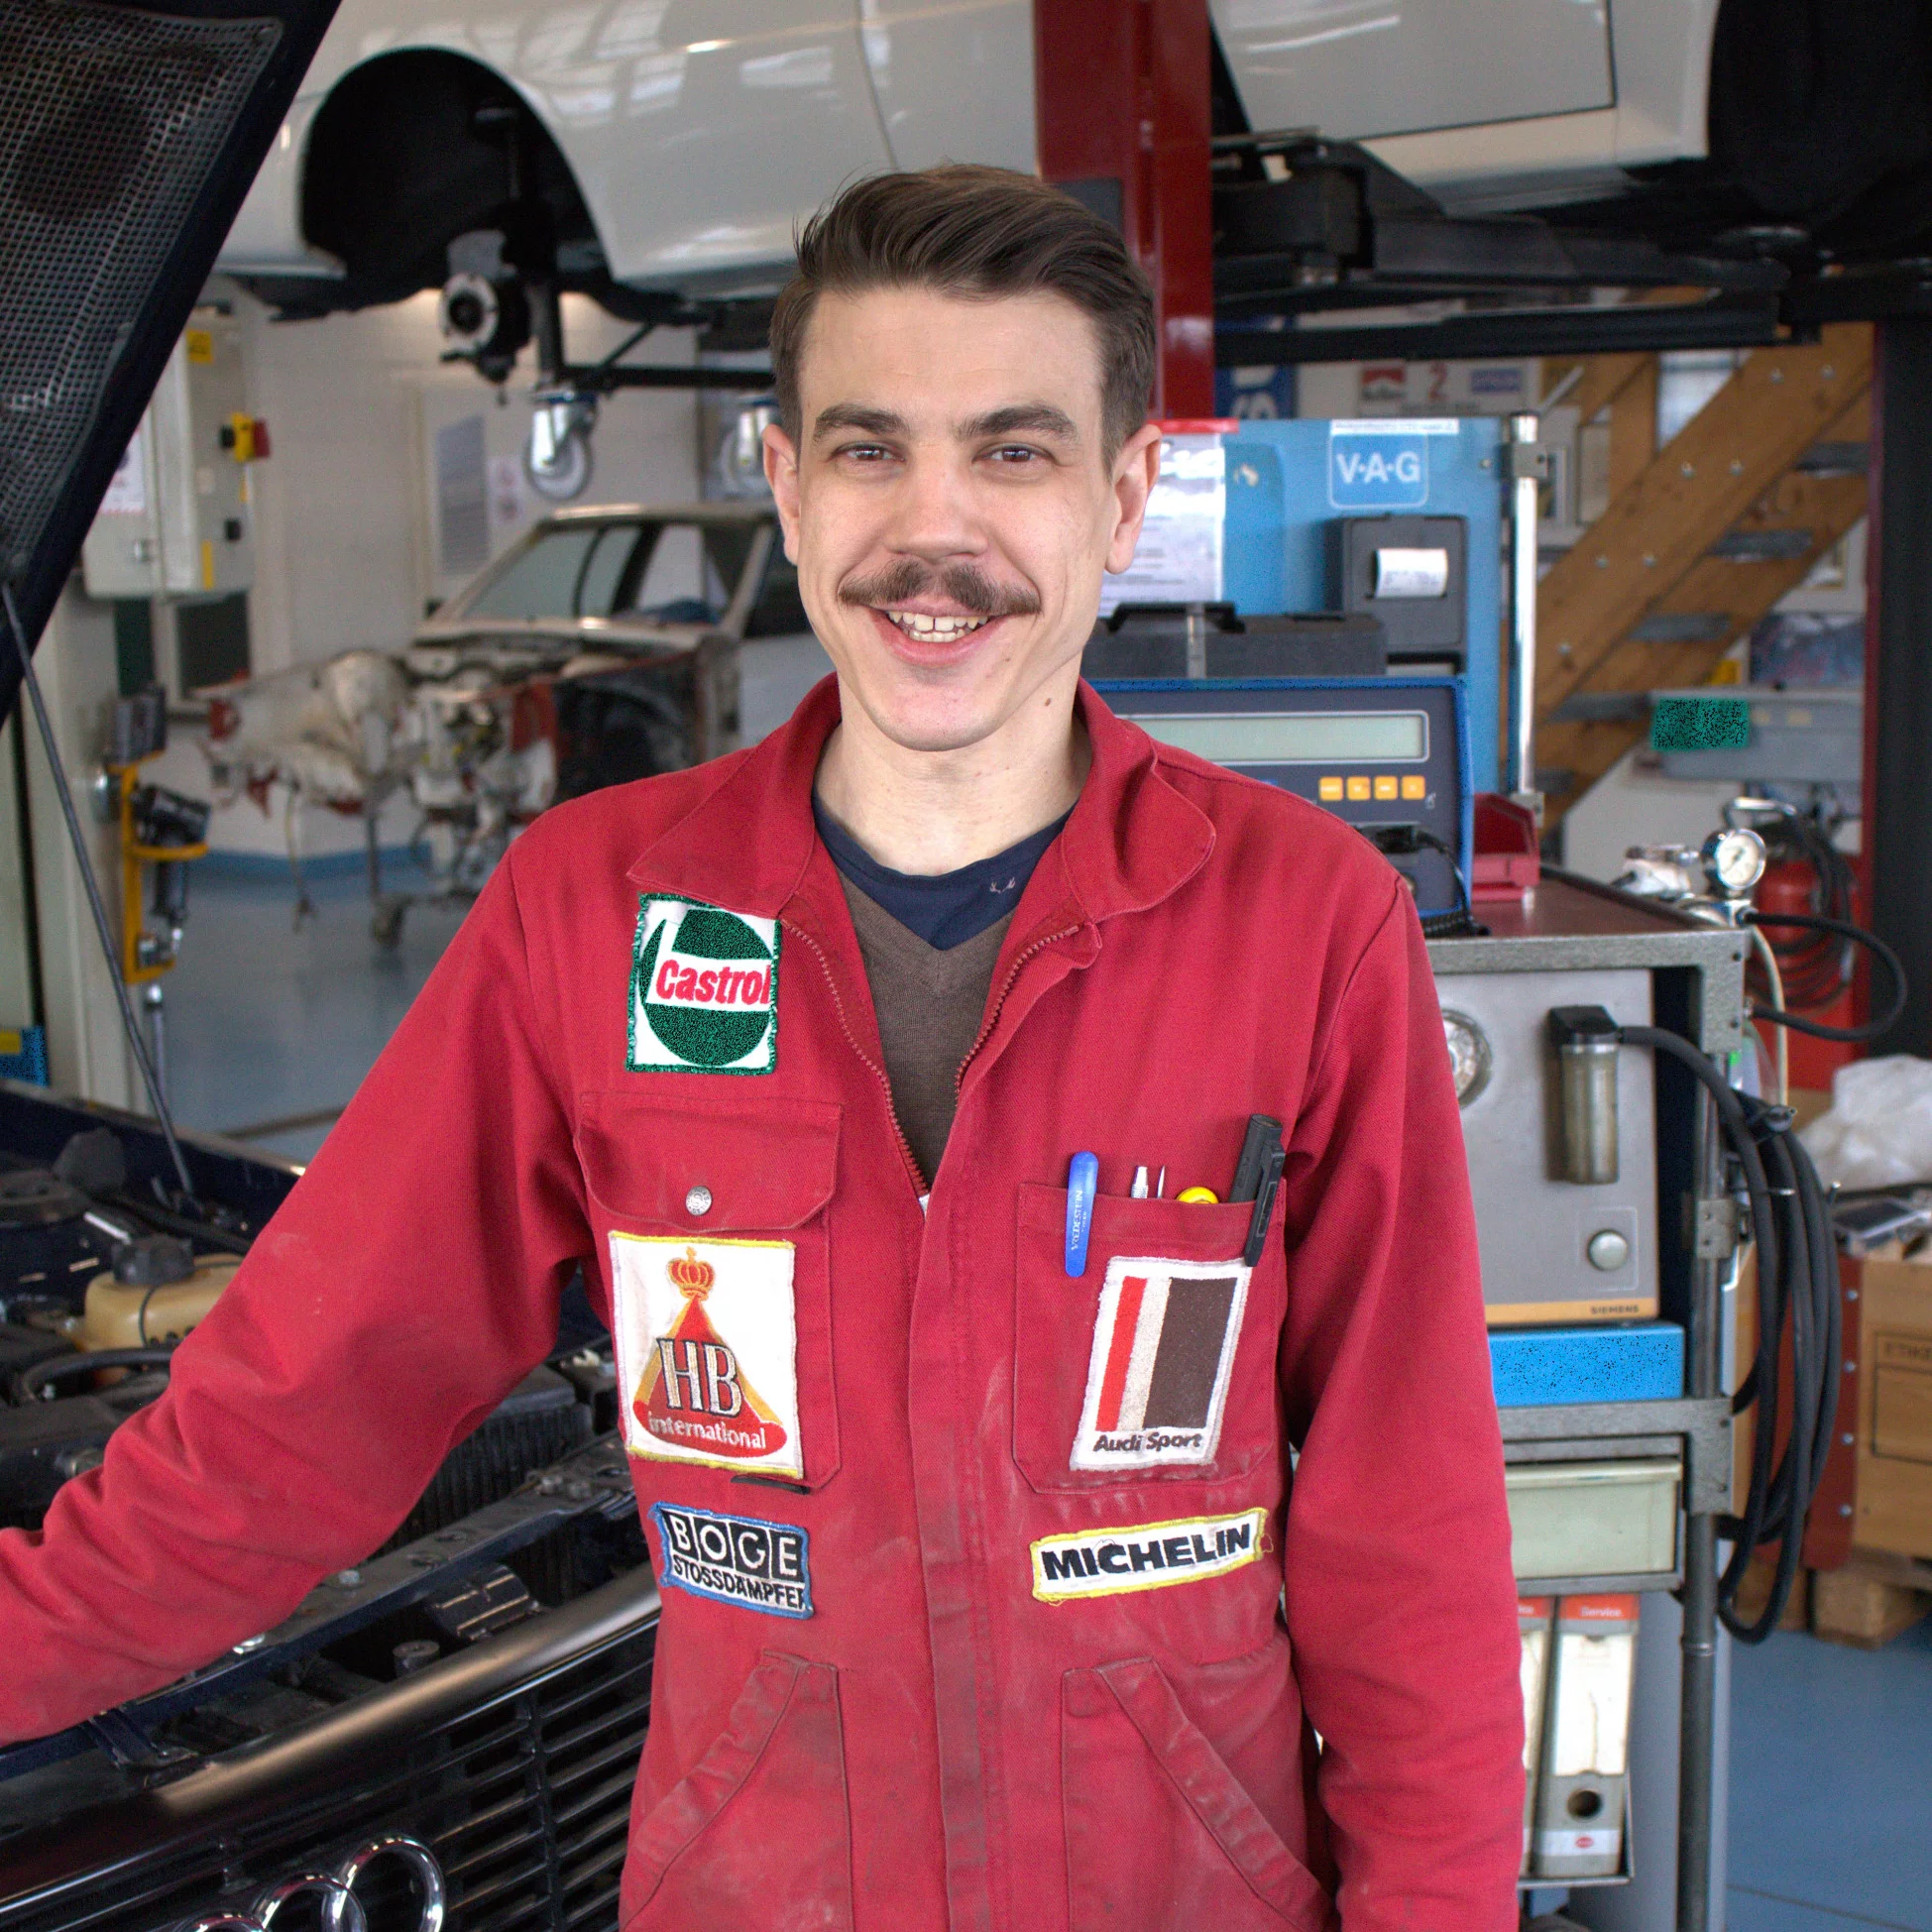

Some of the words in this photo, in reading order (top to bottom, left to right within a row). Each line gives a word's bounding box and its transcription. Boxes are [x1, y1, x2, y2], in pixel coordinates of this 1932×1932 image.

[655, 959, 772, 1005] Castrol
[1591, 1305, 1640, 1315] SIEMENS
[656, 1338, 742, 1418] HB
[647, 1412, 766, 1449] international
[1093, 1434, 1140, 1451] Audi
[1146, 1432, 1201, 1450] Sport
[669, 1515, 797, 1576] BOGE
[1041, 1524, 1251, 1580] MICHELIN
